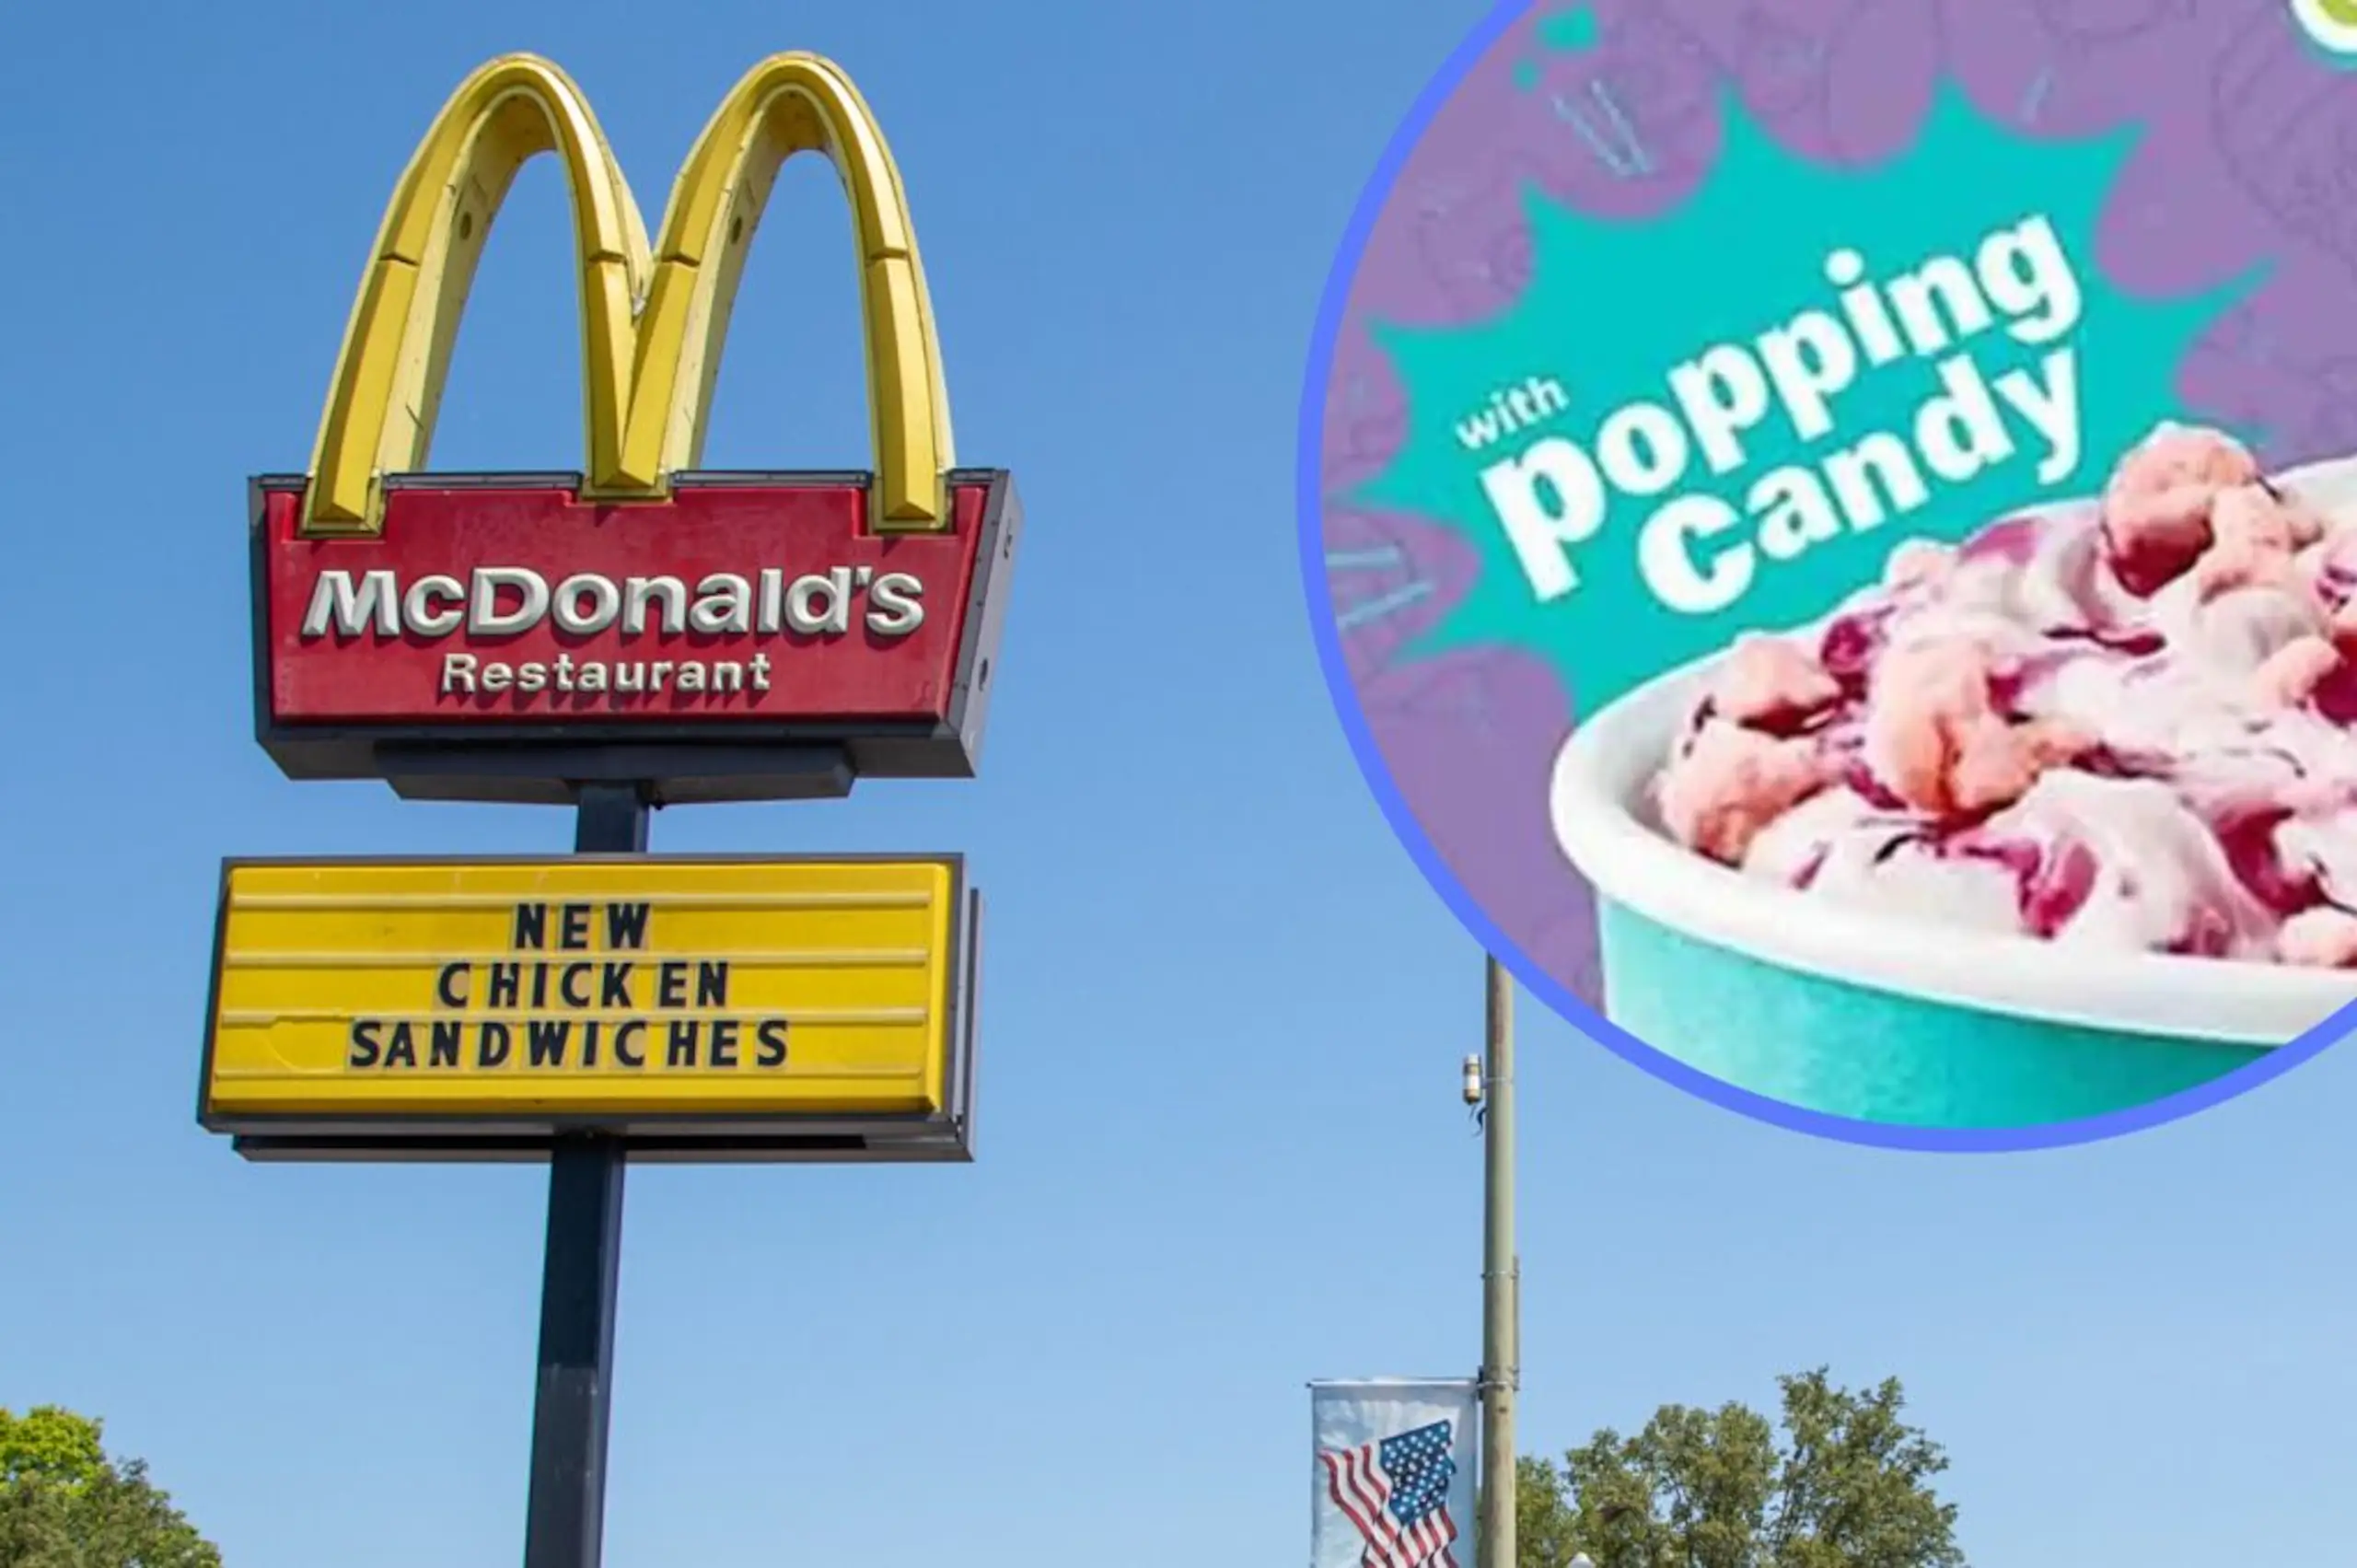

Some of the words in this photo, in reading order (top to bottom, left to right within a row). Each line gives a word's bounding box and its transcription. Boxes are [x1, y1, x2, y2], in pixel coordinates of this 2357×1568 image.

[1455, 376, 1568, 451] with
[1480, 214, 2082, 602] popping
[302, 565, 925, 638] McDonald's
[442, 652, 772, 695] Restaurant
[515, 902, 650, 949] NEW
[437, 962, 728, 1008] CHICKEN
[350, 1020, 788, 1068] SANDWICHES
